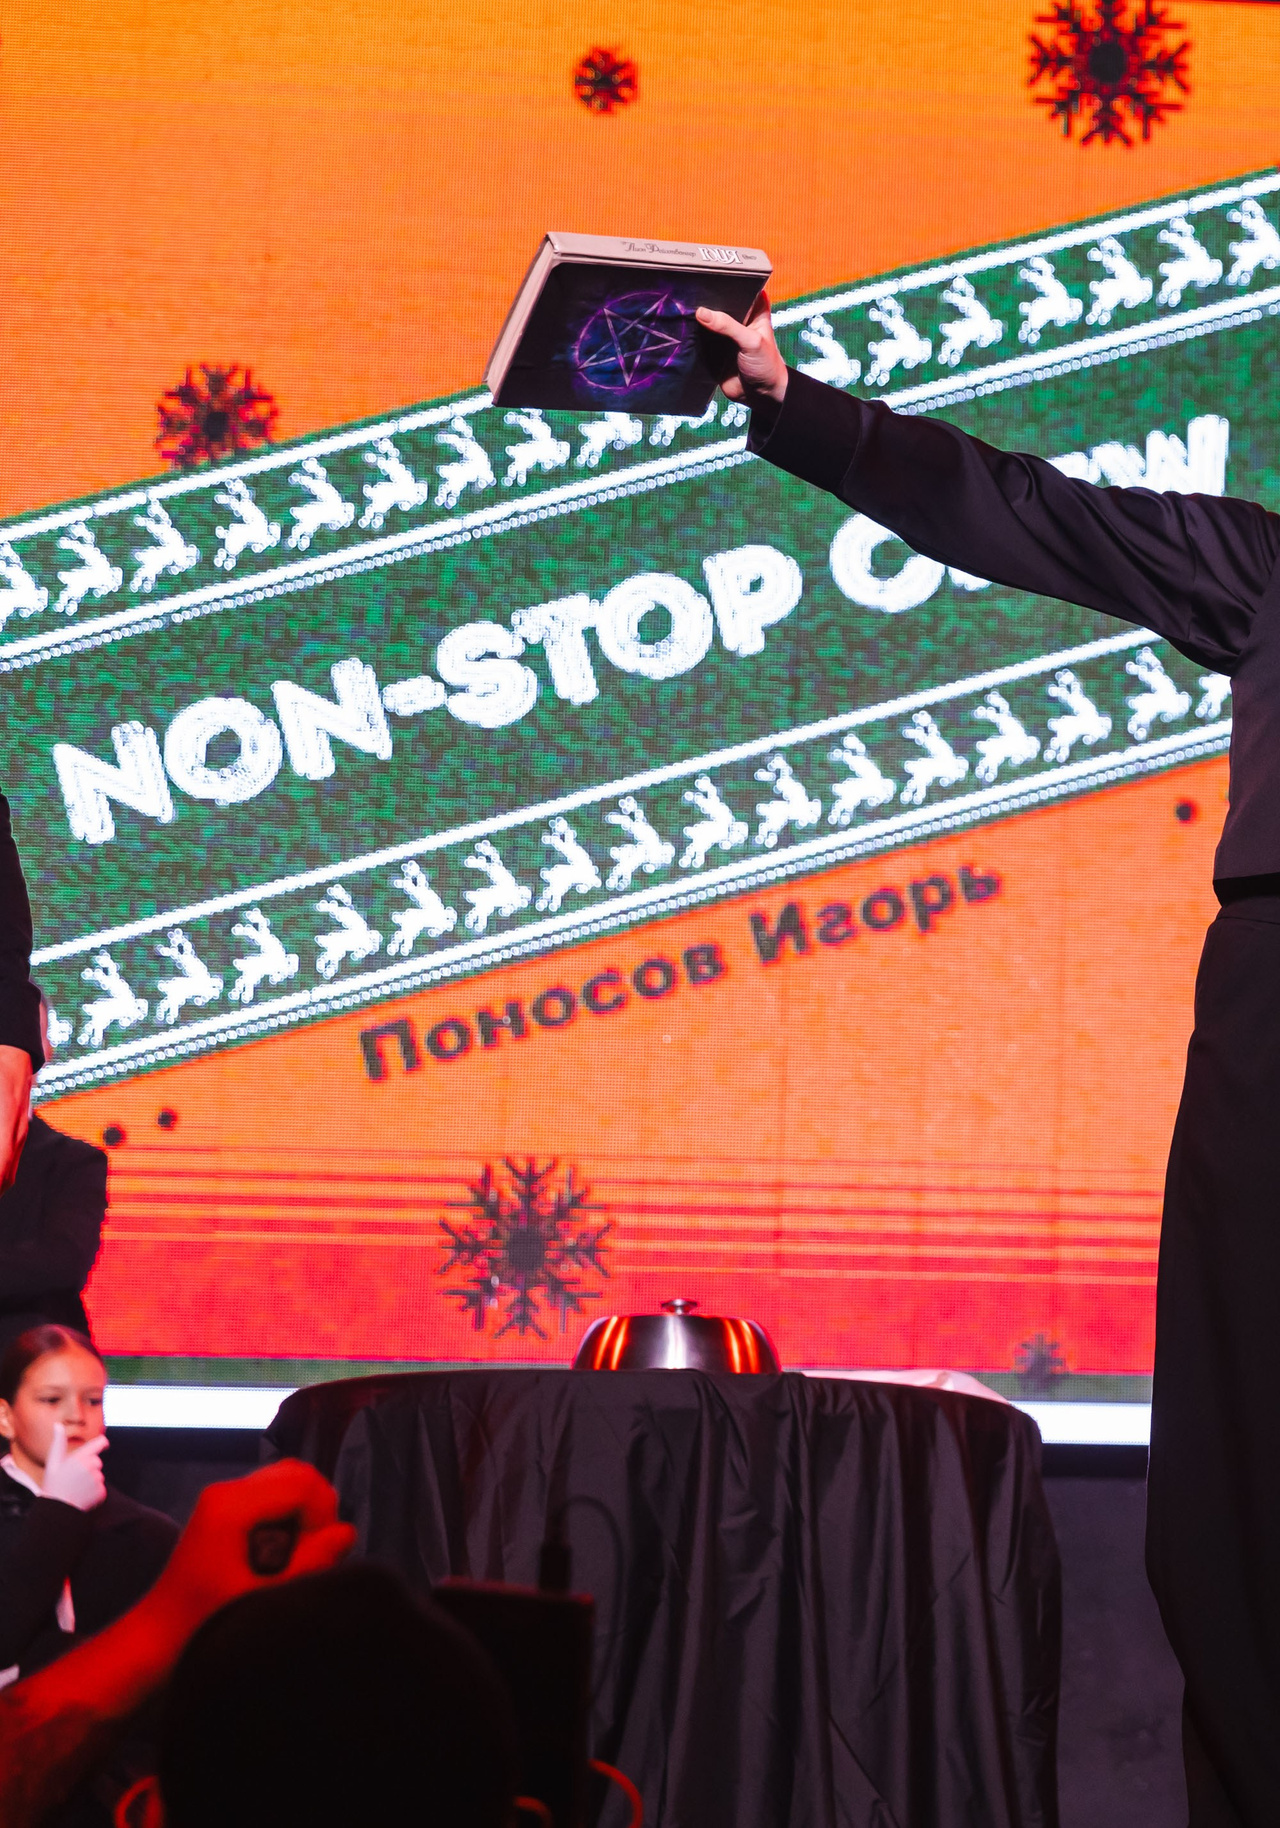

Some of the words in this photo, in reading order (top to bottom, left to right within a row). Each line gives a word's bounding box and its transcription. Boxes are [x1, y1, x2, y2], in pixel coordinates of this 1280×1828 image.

[52, 544, 803, 845] NON-STOP
[358, 940, 725, 1081] Поносов
[750, 862, 1001, 965] Игорь
